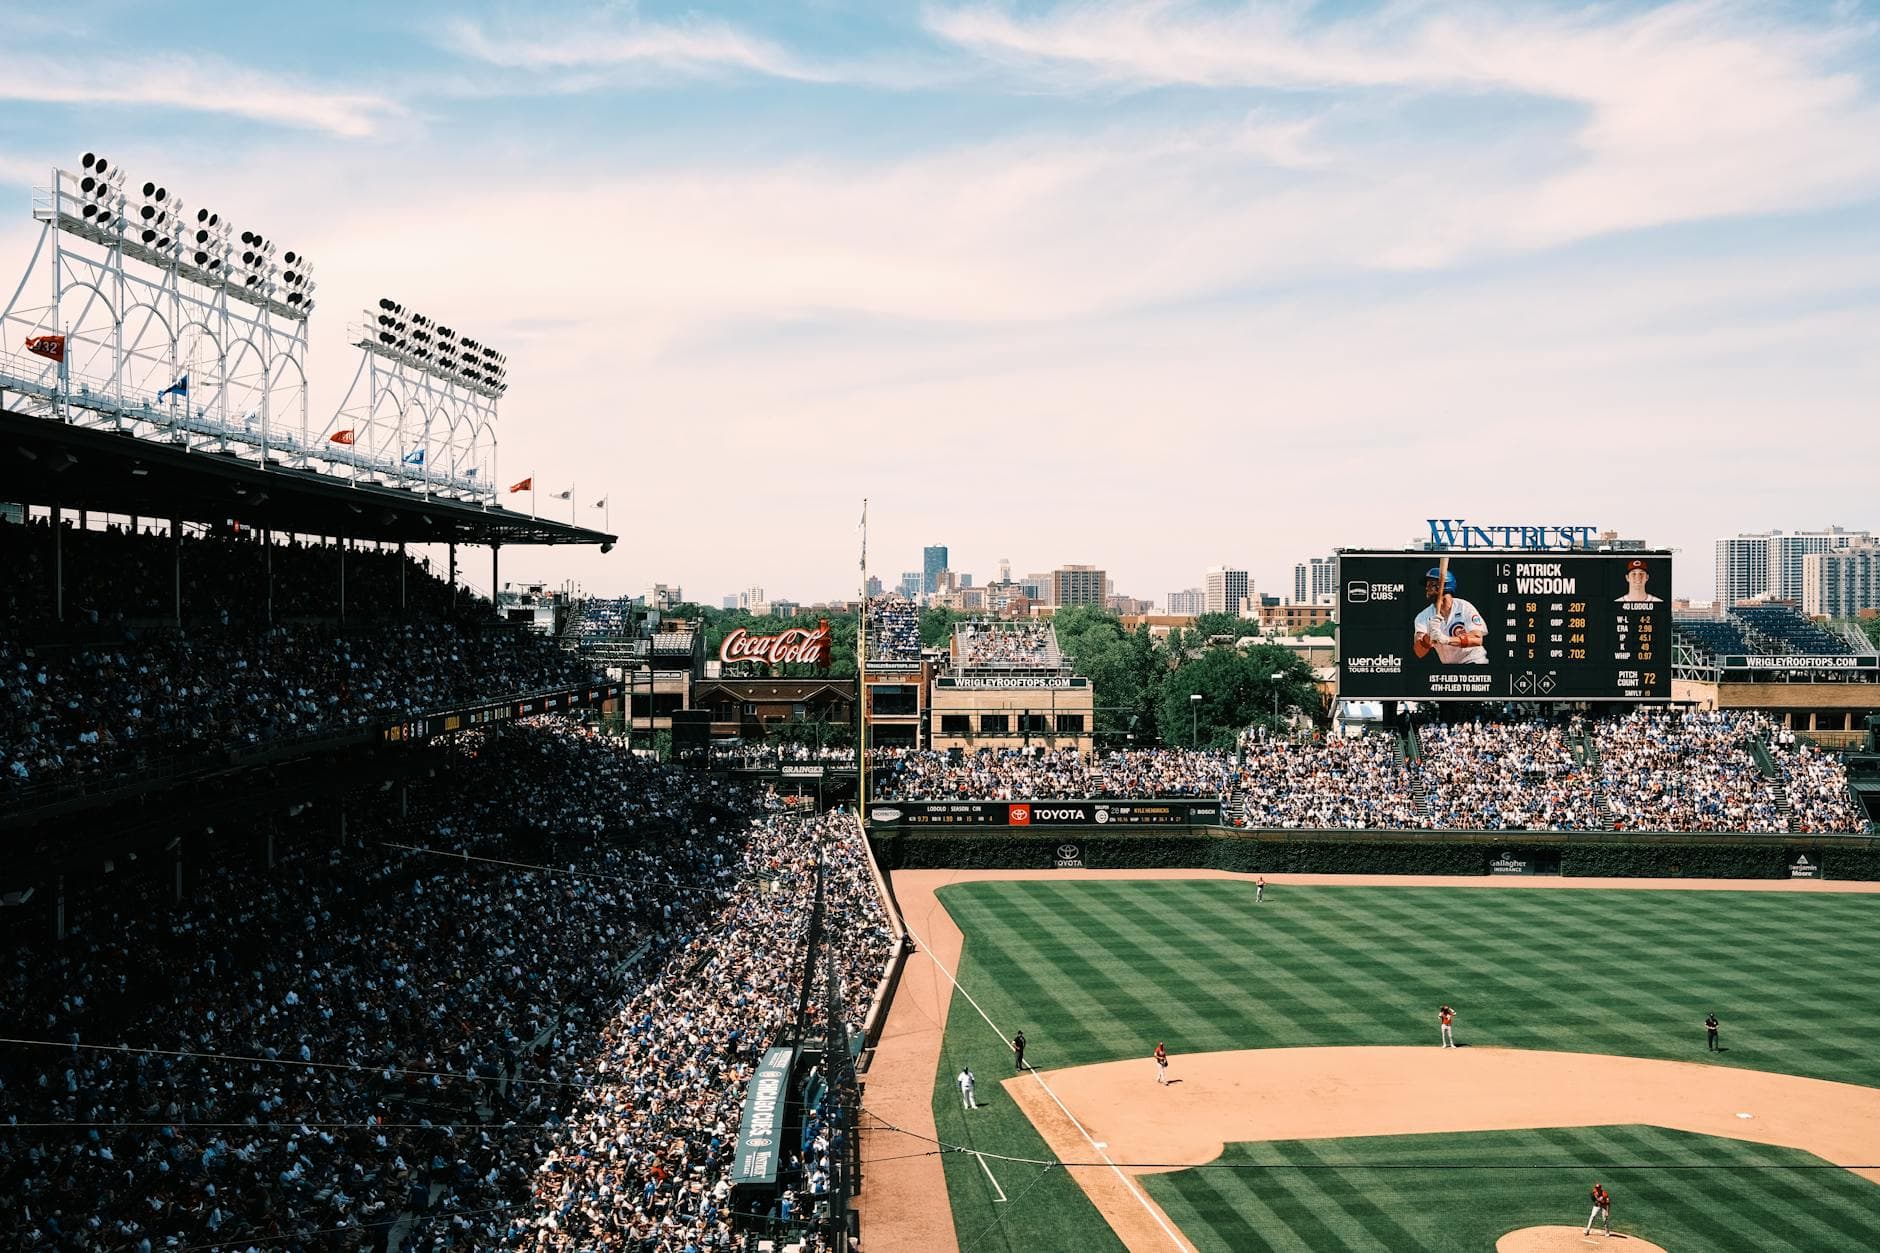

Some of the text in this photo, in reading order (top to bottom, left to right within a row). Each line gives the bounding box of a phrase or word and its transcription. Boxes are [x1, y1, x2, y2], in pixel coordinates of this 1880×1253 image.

[1427, 519, 1597, 549] WINTRUST
[1496, 563, 1562, 577] 16 PATRICK
[1371, 584, 1404, 592] STREAM
[1516, 578, 1576, 594] WISDOM
[1526, 603, 1537, 612] 58
[1568, 603, 1585, 613] .207
[1529, 618, 1535, 628] 2
[1527, 634, 1536, 643] 10
[1551, 634, 1563, 642] SLG
[1569, 634, 1585, 643] .414
[1529, 649, 1535, 659] 5
[1568, 649, 1585, 659] .702
[1348, 654, 1402, 666] wendella
[1746, 657, 1857, 666] WRIGLEYROOFTOPS.COM
[1459, 675, 1467, 683] TO
[1468, 675, 1492, 683] CENTER
[1618, 671, 1638, 679] PITCH
[1644, 673, 1656, 685] 72
[954, 678, 1070, 687] WRIGLEYROOFTOPS.COM
[1034, 809, 1086, 820] TOYOTA
[1490, 860, 1527, 868] Gallagher
[754, 1079, 779, 1112] CHICAGO
